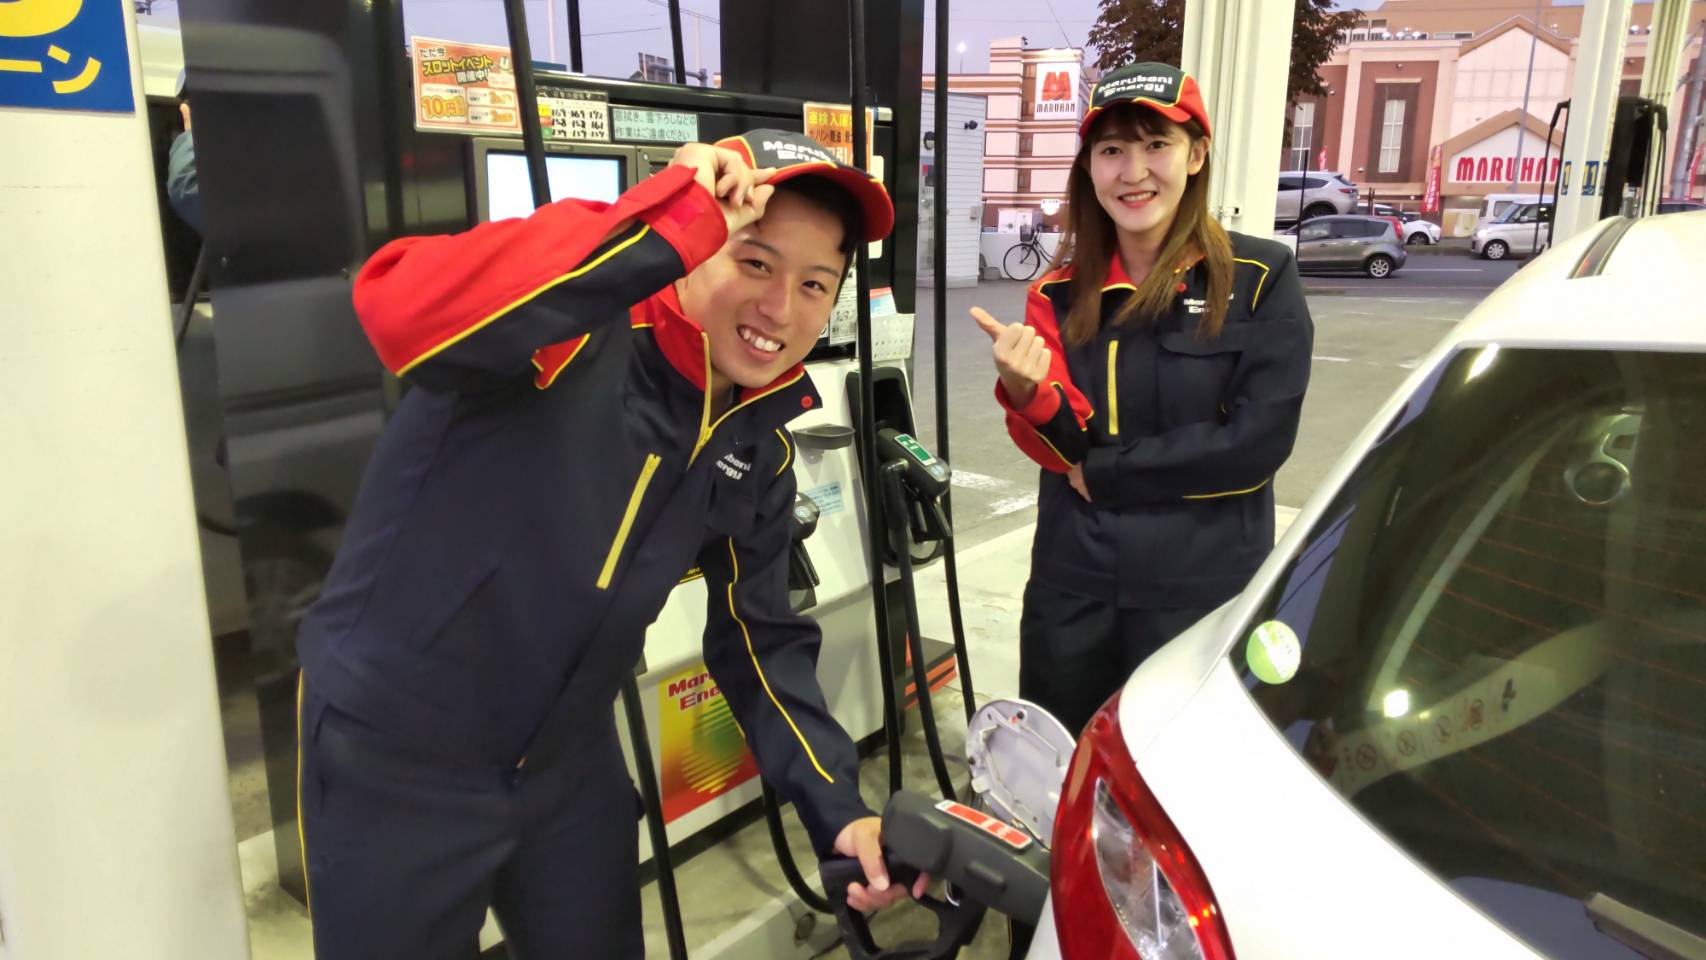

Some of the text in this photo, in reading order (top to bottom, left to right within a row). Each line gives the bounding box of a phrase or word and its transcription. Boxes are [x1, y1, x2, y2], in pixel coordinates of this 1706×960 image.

[422, 54, 493, 77] スロットイベント
[1036, 103, 1076, 113] MARUHAN
[808, 111, 852, 127] 車検入庫
[615, 127, 690, 141] 作業はご遠慮ください
[668, 672, 709, 698] Mar
[679, 686, 720, 712] Ene
